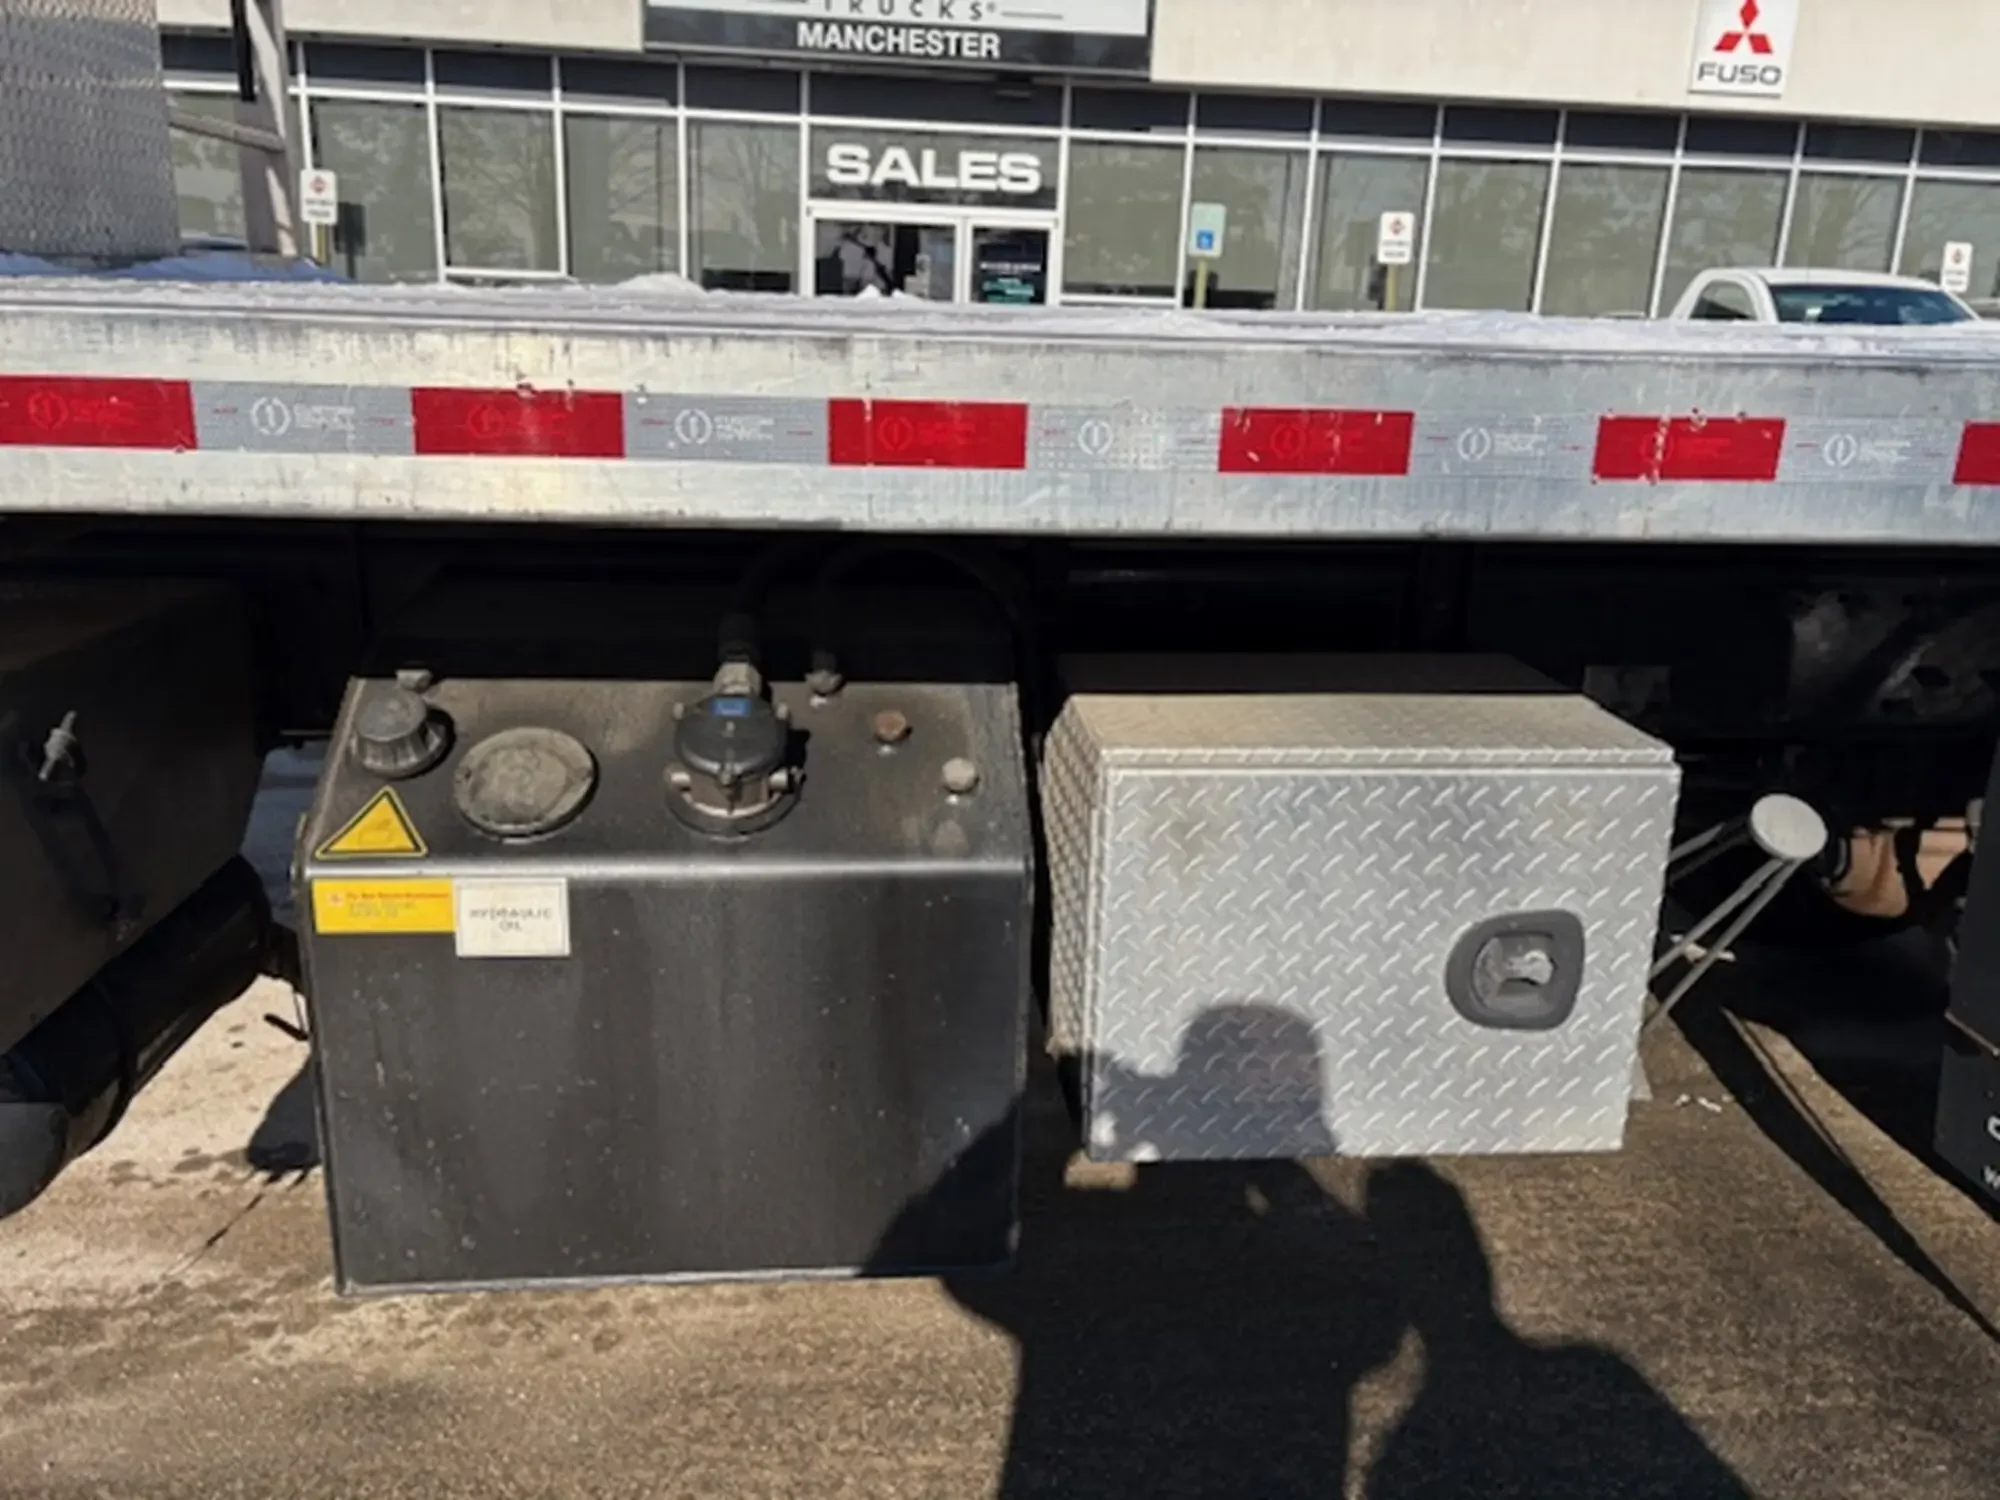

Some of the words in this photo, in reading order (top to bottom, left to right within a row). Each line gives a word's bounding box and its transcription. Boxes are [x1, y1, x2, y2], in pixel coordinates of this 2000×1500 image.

[797, 21, 1000, 59] MANCHESTER
[1697, 62, 1782, 86] FUSO
[826, 143, 1042, 195] SALES
